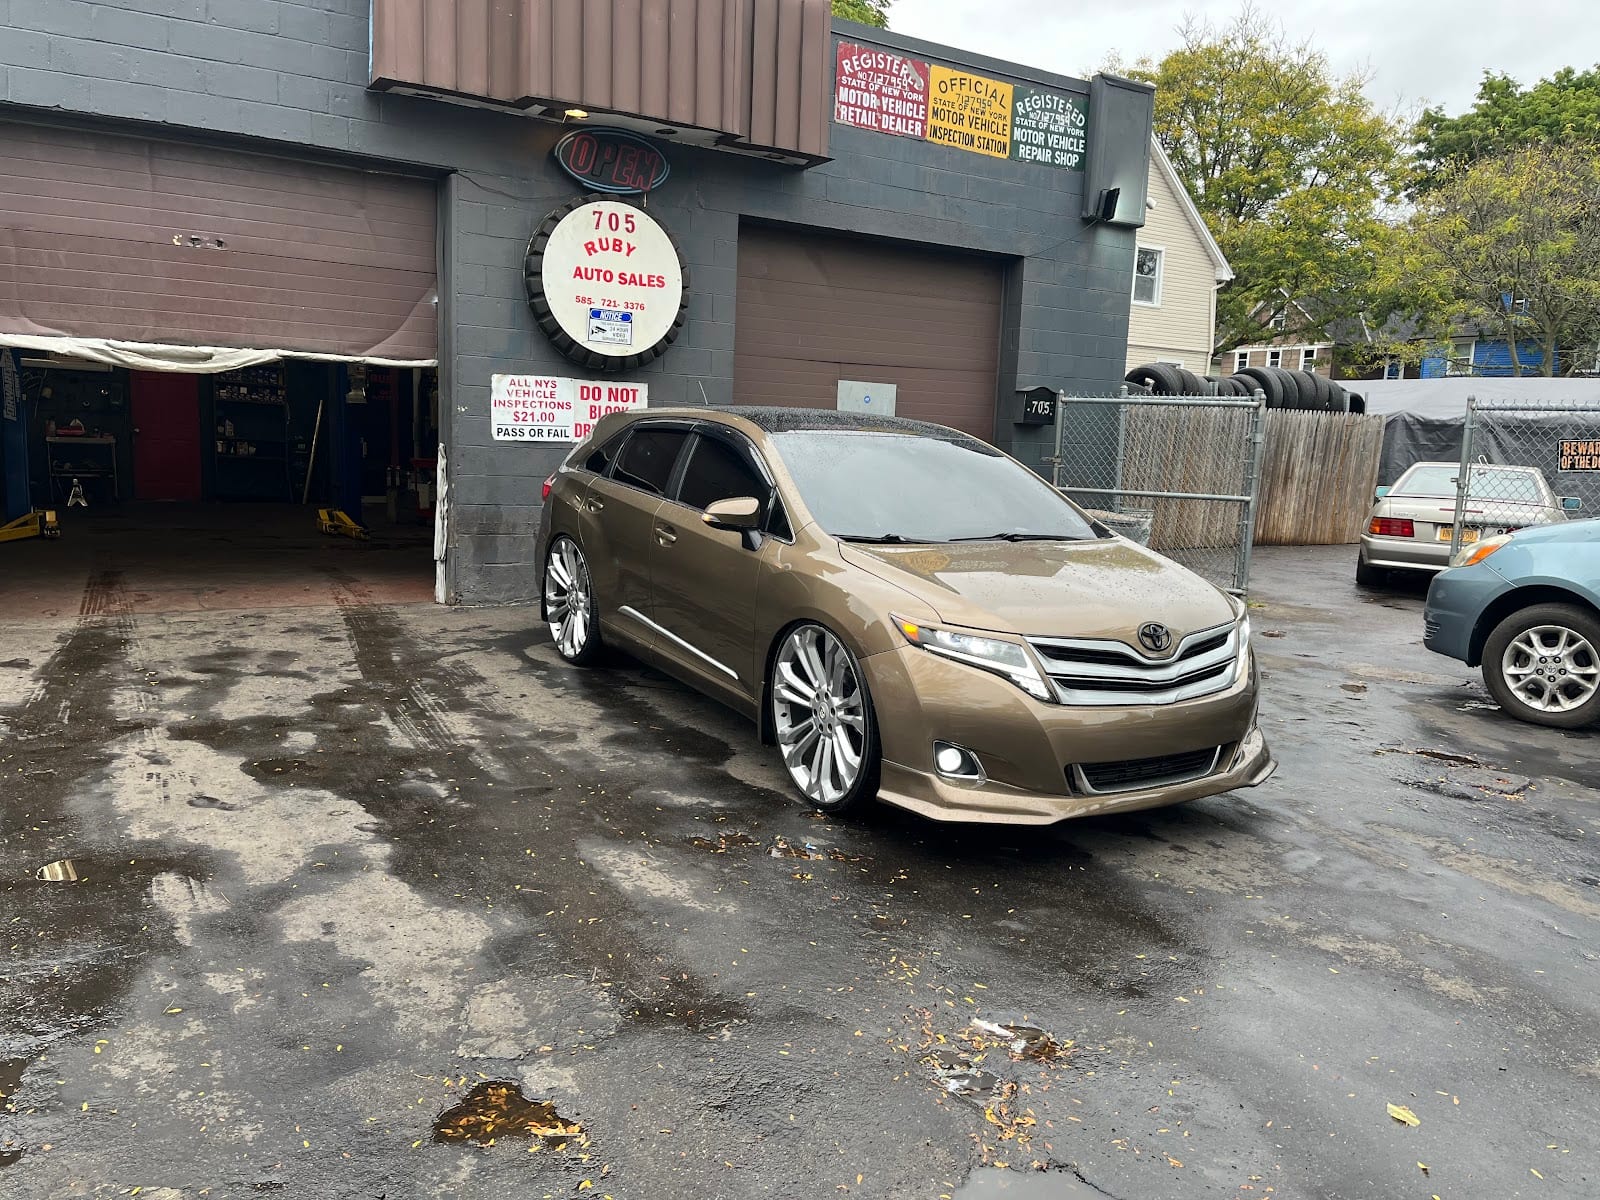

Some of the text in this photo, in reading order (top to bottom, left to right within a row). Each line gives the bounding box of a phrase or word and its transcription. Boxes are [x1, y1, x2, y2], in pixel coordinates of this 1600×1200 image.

[841, 76, 924, 102] STATE OF NEW YORK
[938, 77, 1006, 109] OFFICIAL
[839, 86, 925, 119] MOTOR VEHICLE
[933, 97, 1007, 121] STATE OF NEW YORK
[1016, 94, 1085, 126] REGISTERED
[840, 105, 922, 136] RETAIL DEALER
[932, 106, 1008, 136] MOTOR VEHICLE
[1015, 117, 1085, 137] STATE OF NEW YORK
[929, 124, 1007, 154] INSPECTION STATION
[1014, 127, 1085, 153] MOTOR VEHICLE
[569, 134, 658, 191] OPEN
[1019, 143, 1079, 167] REPAIR SHOP
[592, 210, 636, 234] 705
[583, 237, 636, 257] RUBY
[572, 265, 666, 288] AUTO SALES
[599, 310, 623, 322] NOTICE
[623, 301, 645, 311] 3376
[506, 389, 557, 399] VEHICLE
[509, 378, 557, 389] ALL NYS
[580, 385, 639, 403] DO NOT
[493, 399, 572, 410] INSPECTIONS
[1032, 400, 1050, 414] 705
[513, 411, 555, 423] $21.00
[496, 427, 525, 437] PASS
[528, 428, 544, 438] OR
[547, 429, 570, 438] FAIL
[1561, 455, 1573, 469] OF
[1573, 455, 1591, 469] THE
